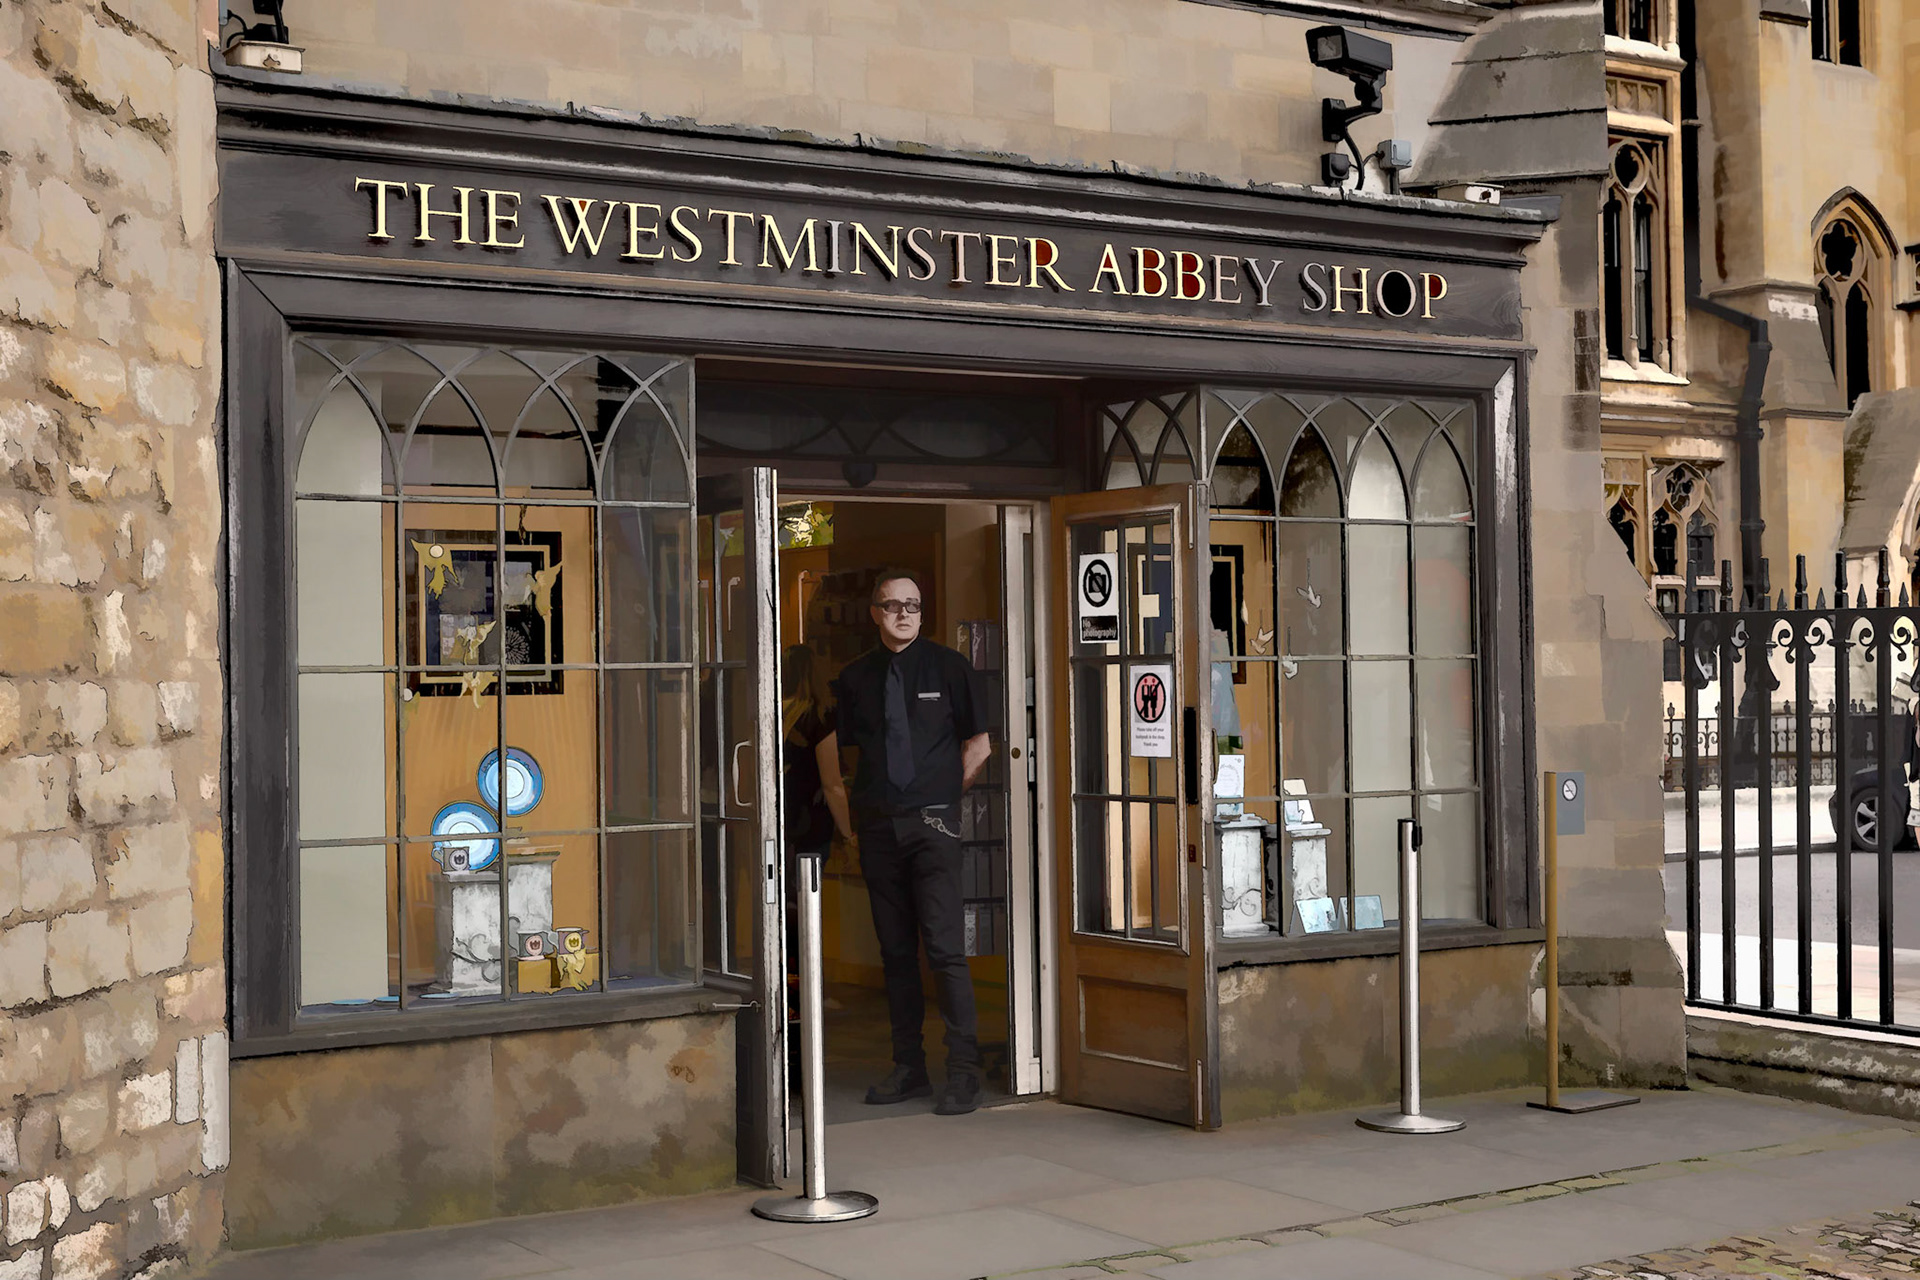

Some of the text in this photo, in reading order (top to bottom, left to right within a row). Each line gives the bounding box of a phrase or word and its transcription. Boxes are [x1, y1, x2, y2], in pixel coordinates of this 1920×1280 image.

[354, 176, 1448, 319] THE WESTMINSTER ABBEY SHOP
[1082, 618, 1091, 628] No
[1083, 628, 1117, 639] photography
